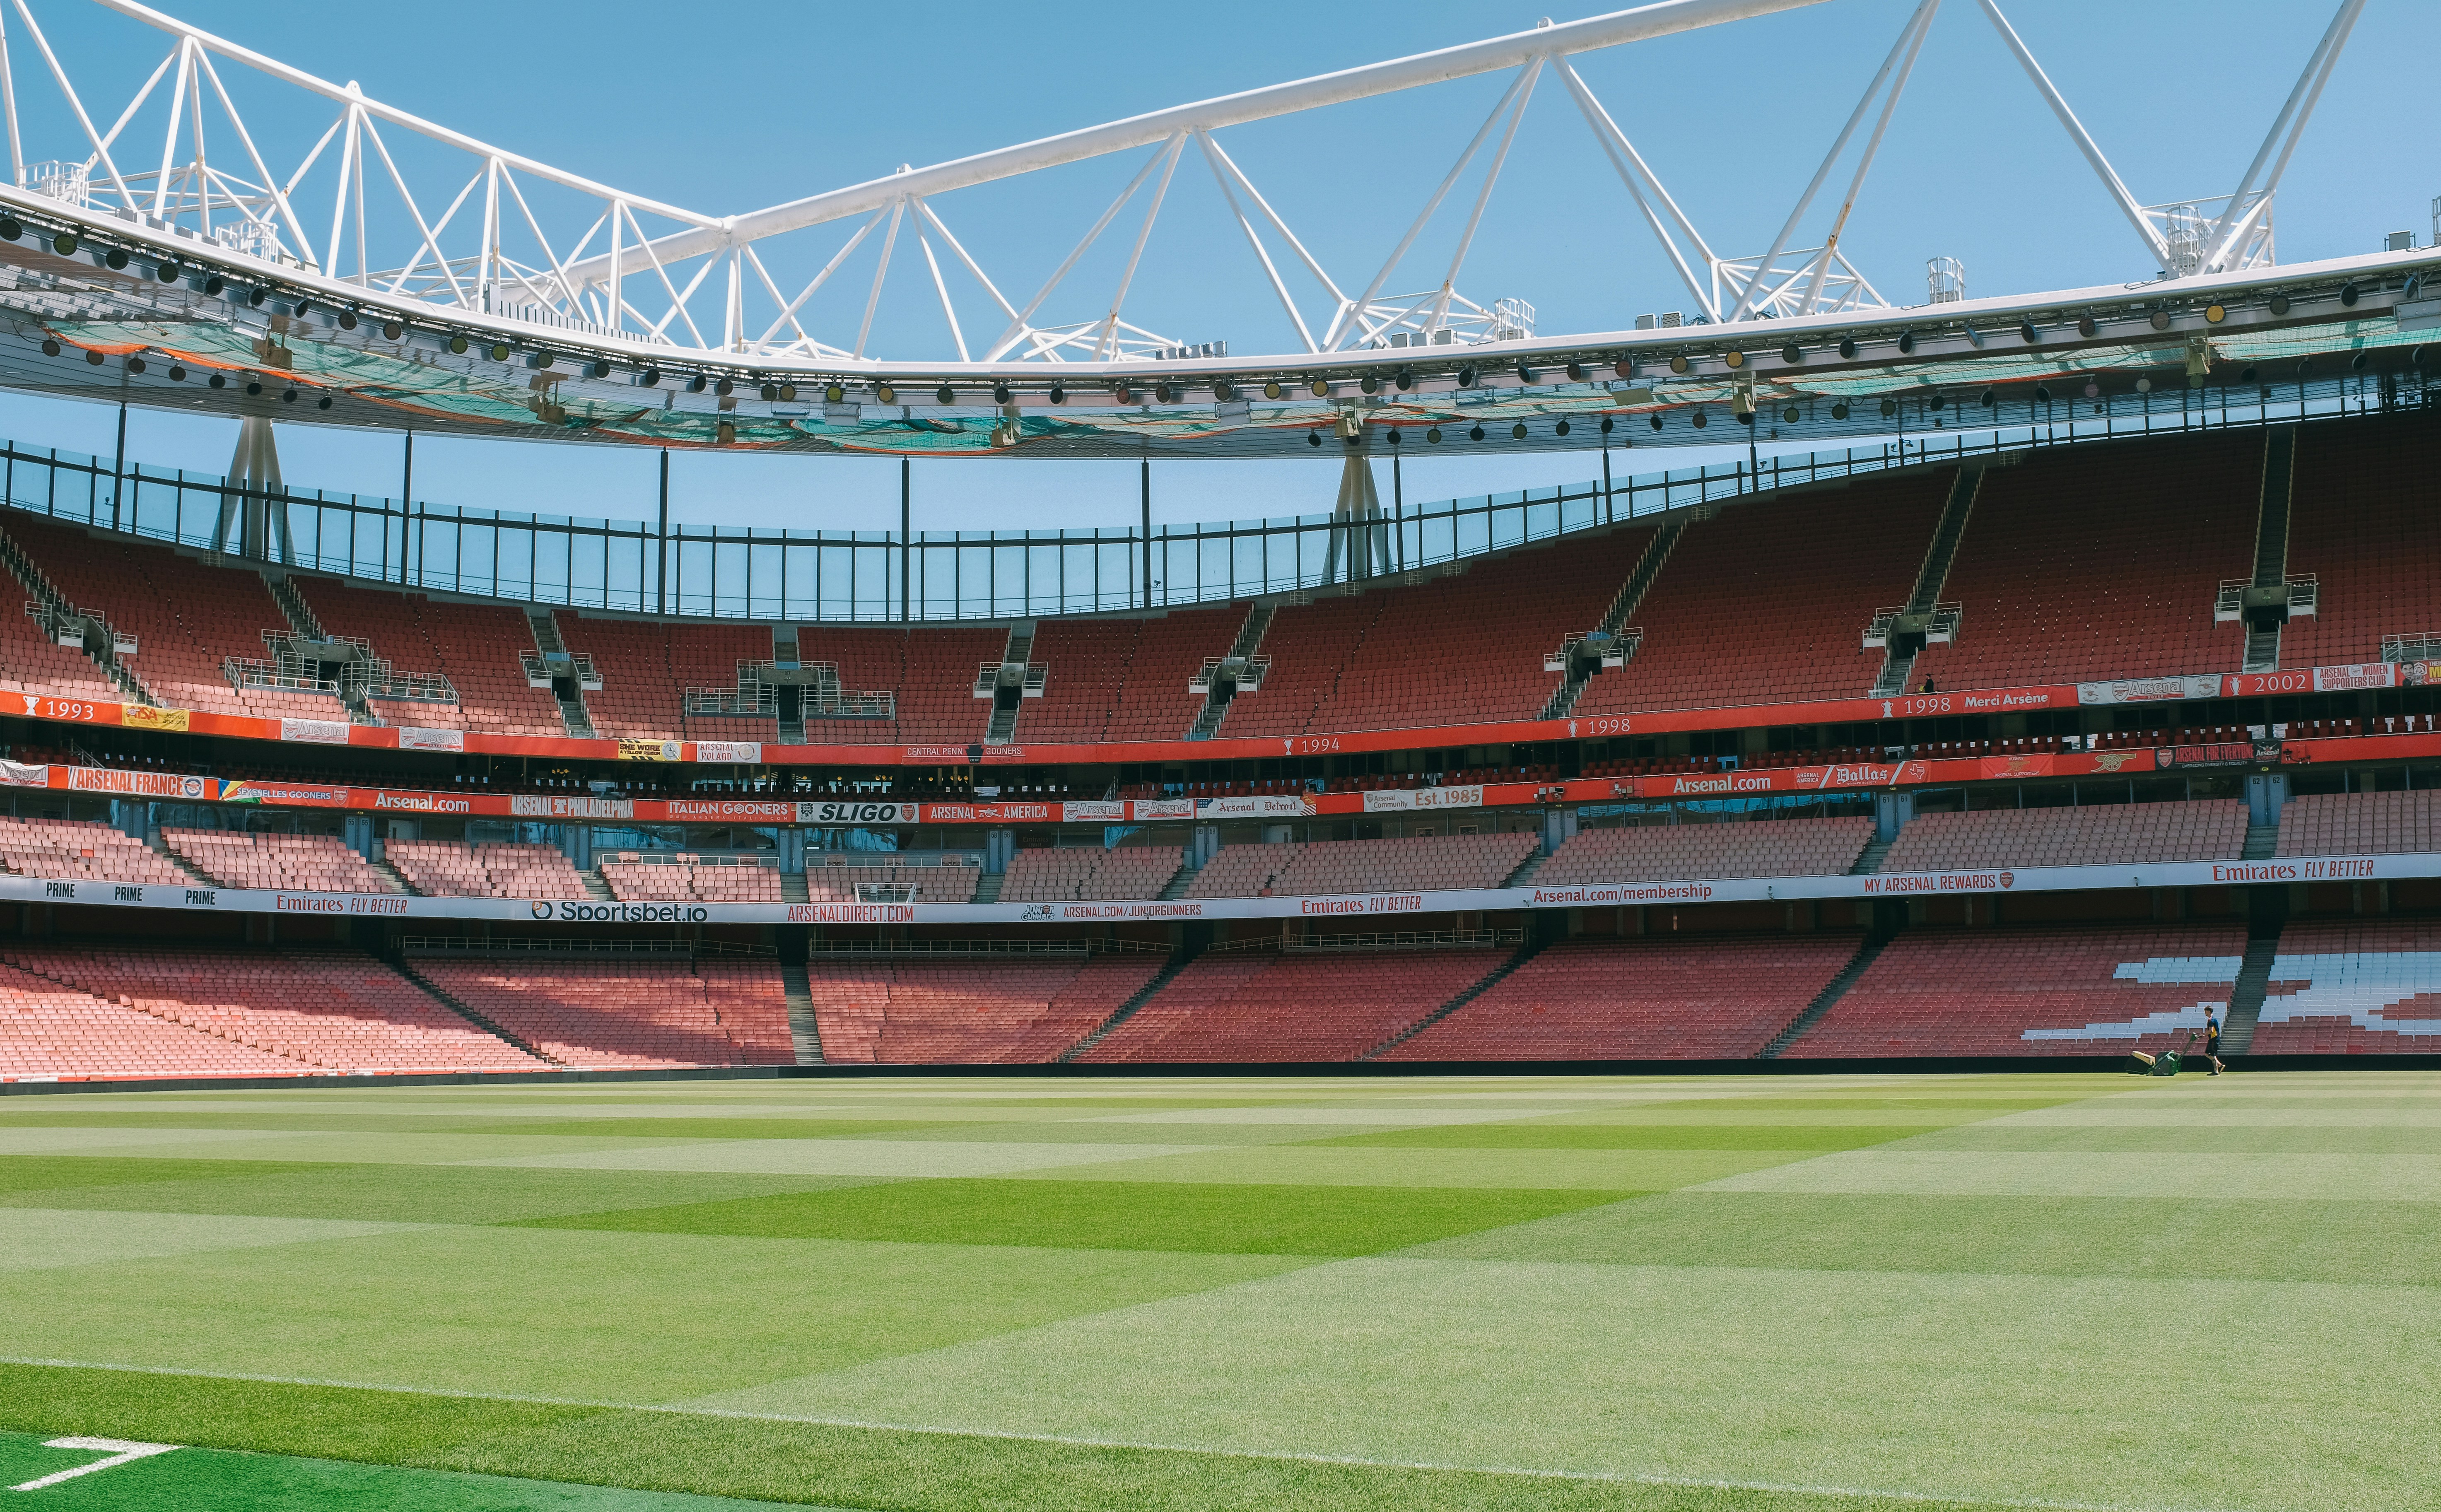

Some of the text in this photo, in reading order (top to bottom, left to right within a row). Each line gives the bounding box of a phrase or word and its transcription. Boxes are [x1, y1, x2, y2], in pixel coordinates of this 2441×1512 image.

[2320, 664, 2388, 678] ARSENAL WOMEN
[2129, 678, 2184, 695] Arsenal
[2255, 674, 2306, 692] 2002
[2322, 674, 2386, 690] SUPPORTERS CLUB
[1905, 697, 1951, 714] 1998
[1965, 692, 2048, 707] Merci Arsène
[47, 701, 94, 720] 1993
[299, 721, 347, 736] Arsenal
[1588, 718, 1631, 734] 1998
[415, 730, 463, 744] Arsenal
[1302, 738, 1340, 753] 1994
[700, 743, 733, 751] ARSENAL
[986, 747, 1021, 755] GOONERS
[2175, 743, 2254, 762] ARSENAL FOR EVERYONE
[702, 752, 732, 761] POLAND
[0, 762, 46, 780] Arsenal
[1836, 766, 1888, 784] Dallas
[76, 769, 183, 796] ARSENAL FRANCE
[1673, 775, 1770, 794] Arsenal.com
[236, 787, 331, 800] SEYCHELLES GOONERS
[1416, 789, 1480, 806] Est. 1985
[374, 792, 470, 813] Arsenal.com
[511, 796, 634, 818] ARSENAL PHILADELPHIA
[669, 802, 788, 815] ITALIAN GOONERS
[1078, 802, 1123, 815] Arsenal
[1150, 801, 1191, 813] Arsenal
[1217, 801, 1297, 813] Arsenal Detroit
[819, 804, 896, 822] SLIGO
[931, 805, 1048, 819] ARSENAL AMERICA
[2212, 860, 2374, 881] Emirates FLY BETTER
[46, 882, 75, 898] PRIME
[1865, 874, 1996, 892] MY ARSENAL REWARDS
[115, 886, 142, 902] PRIME
[186, 890, 216, 905] PRIME
[1534, 883, 1712, 903] Arsenal.com/membership
[277, 895, 408, 914] Emirates FLY BETTER
[560, 902, 708, 922] Sportsbet.io
[1301, 896, 1421, 914] Emirates FLY BETTER
[788, 905, 914, 922] ARSENALDIRECT.COM
